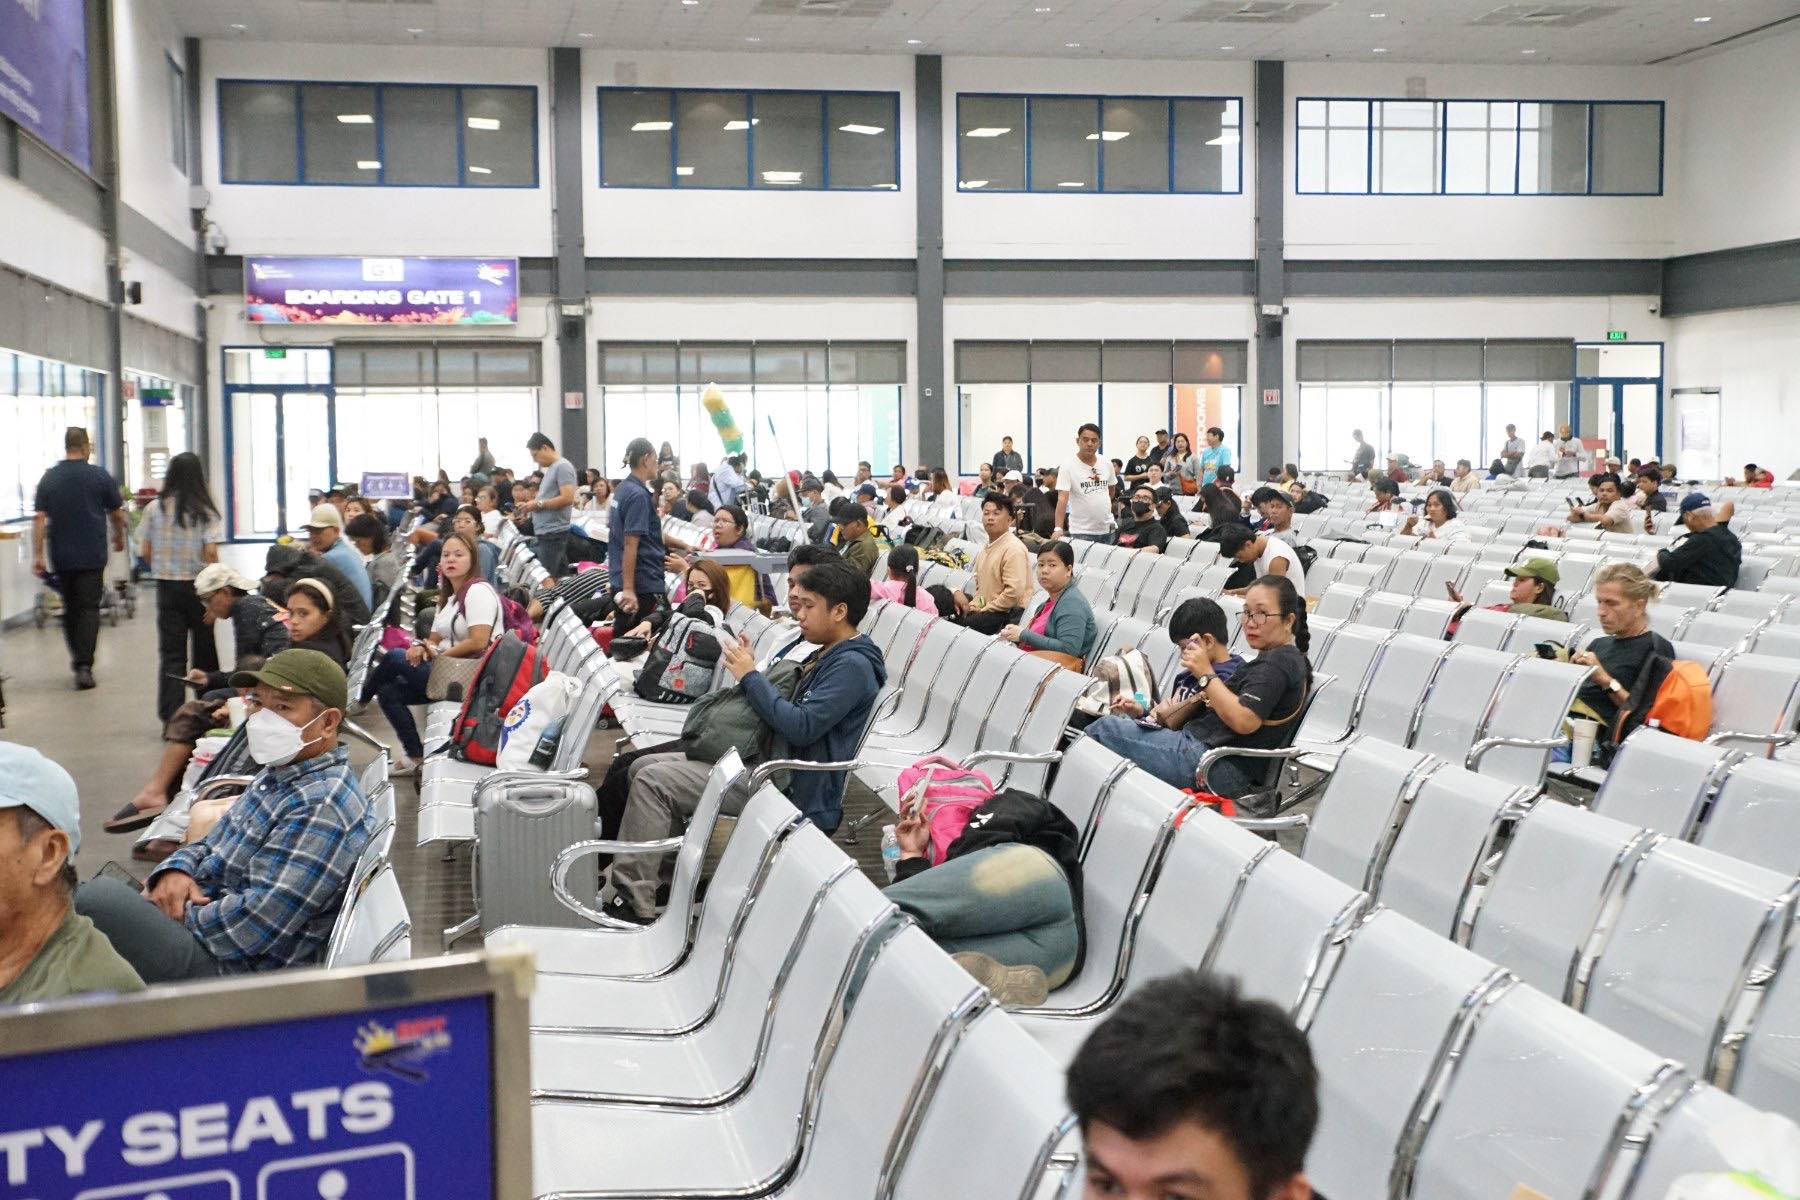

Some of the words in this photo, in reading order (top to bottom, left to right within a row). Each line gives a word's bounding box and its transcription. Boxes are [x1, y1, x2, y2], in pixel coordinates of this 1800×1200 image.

[371, 264, 395, 277] G1
[286, 290, 401, 304] BOARDING
[407, 290, 464, 304] GATE
[469, 290, 481, 304] 1
[121, 1081, 394, 1166] SEATS
